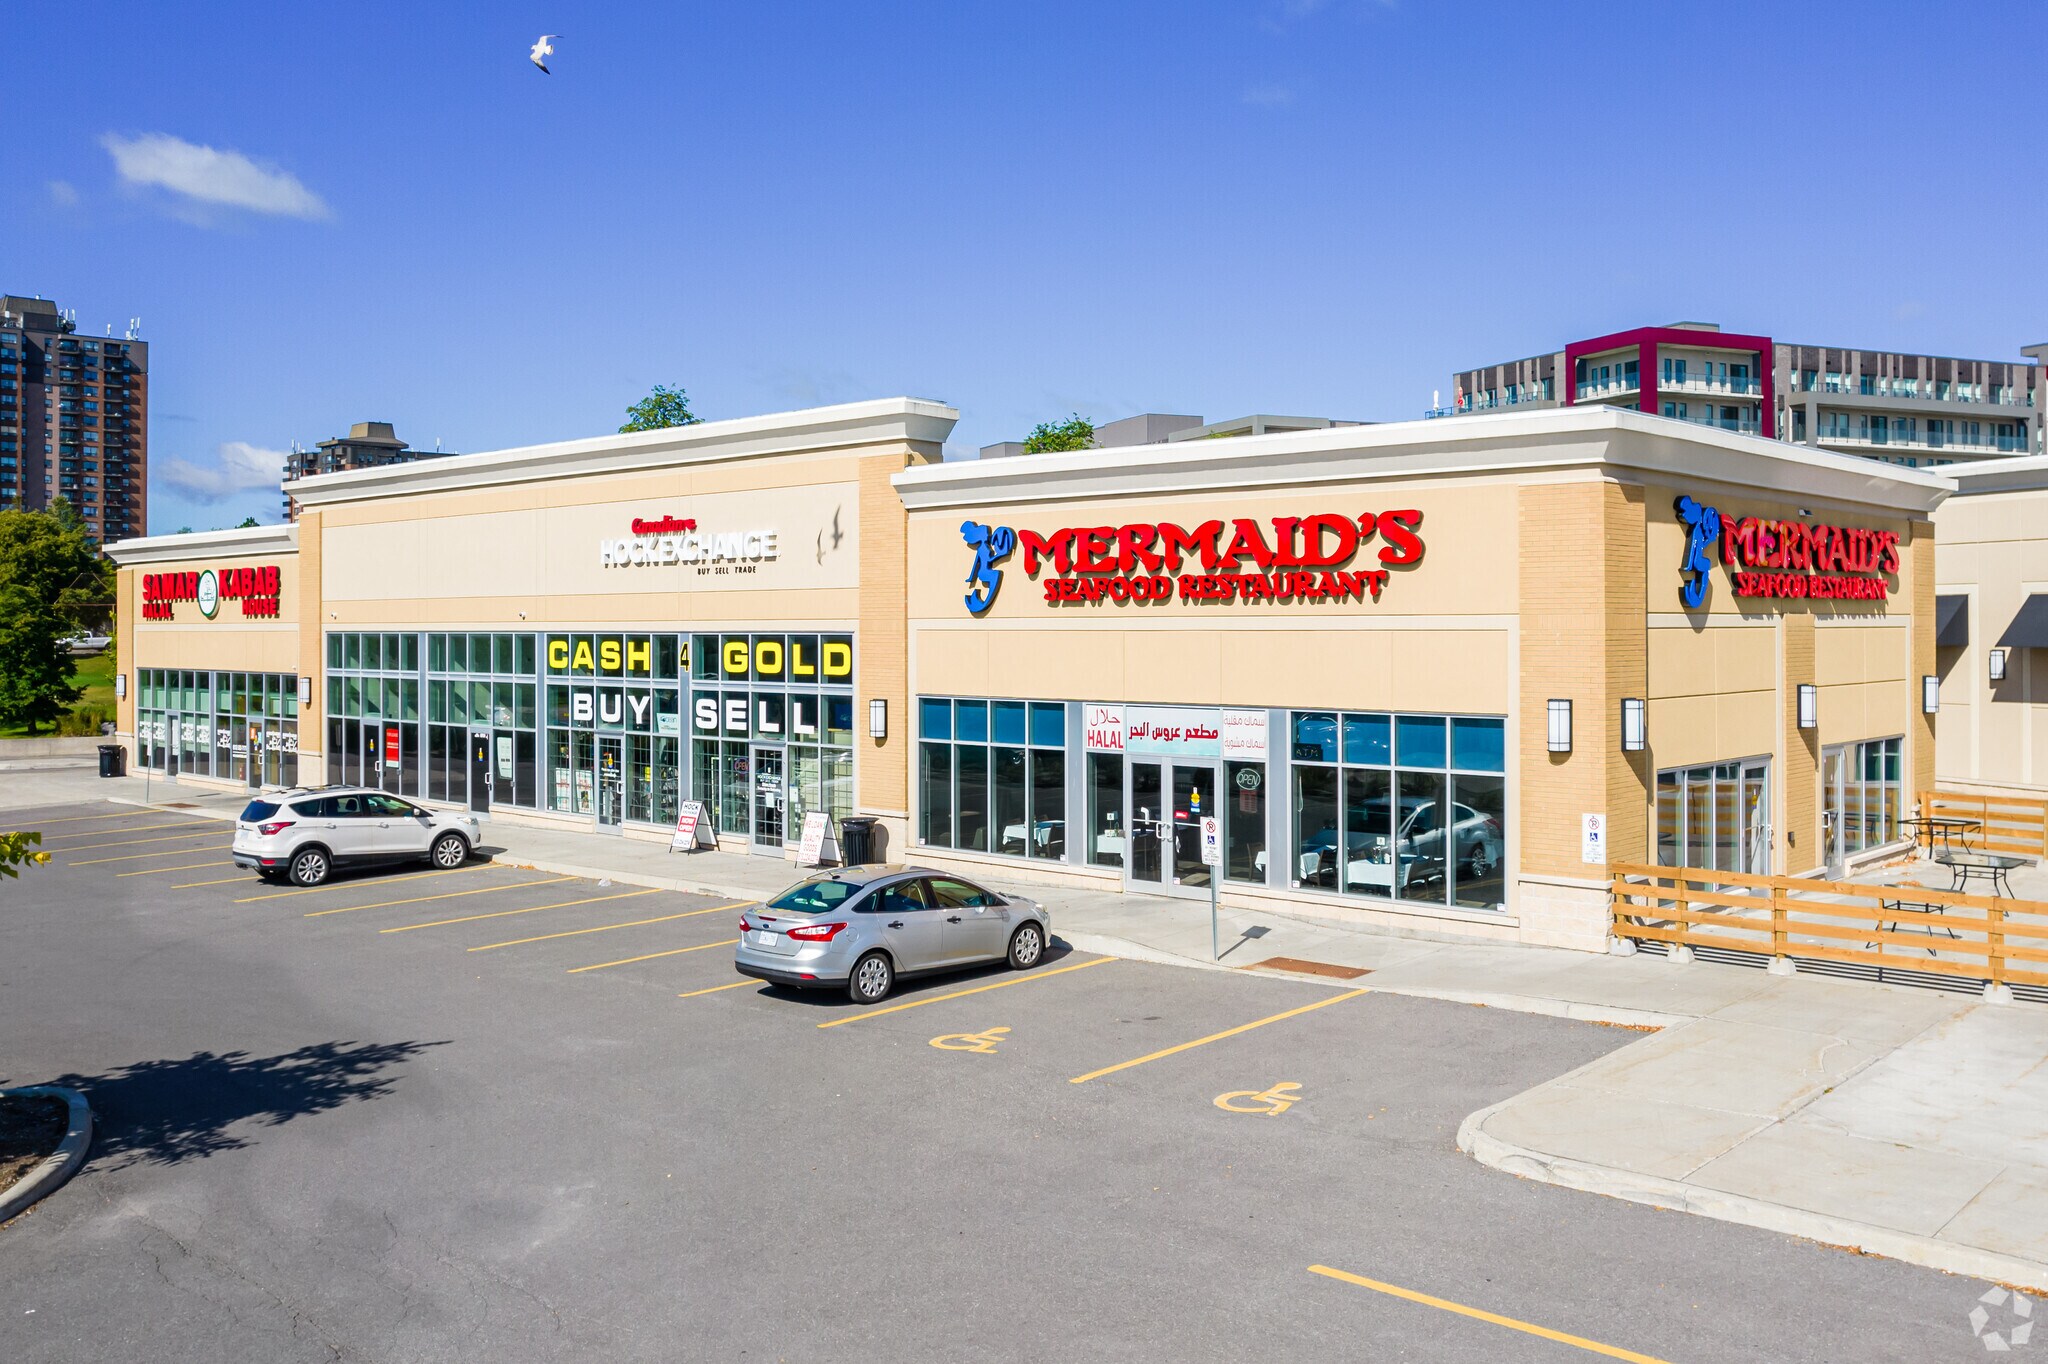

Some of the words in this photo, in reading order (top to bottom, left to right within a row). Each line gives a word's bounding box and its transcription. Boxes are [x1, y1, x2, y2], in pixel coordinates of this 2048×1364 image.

[1018, 508, 1424, 575] MERMAID'S
[1720, 513, 1900, 575] MERMAID'S
[697, 567, 710, 575] BUY
[715, 567, 729, 575] SELL
[734, 565, 756, 574] TRADE
[142, 571, 199, 601] SAMAR
[218, 565, 279, 598] KABAB
[1043, 575, 1171, 601] SEAFOOD
[1178, 569, 1387, 600] RESTAURANT
[1736, 572, 1807, 598] SEAFOOD
[1809, 575, 1889, 600] RESTAURANT
[142, 603, 173, 618] HALAL
[242, 598, 278, 615] HOUSE
[548, 640, 651, 670] CASH
[679, 642, 690, 672] 4
[723, 641, 852, 676] GOLD
[573, 692, 651, 725] BUY
[695, 698, 816, 735] SELL
[1090, 708, 1121, 727] حلال
[1087, 730, 1124, 749] HALAL
[1128, 722, 1150, 741] البحر
[1152, 727, 1181, 742] عروس
[1184, 724, 1219, 742] مطعم
[1296, 749, 1319, 757] ATM
[1238, 773, 1259, 785] OPEN
